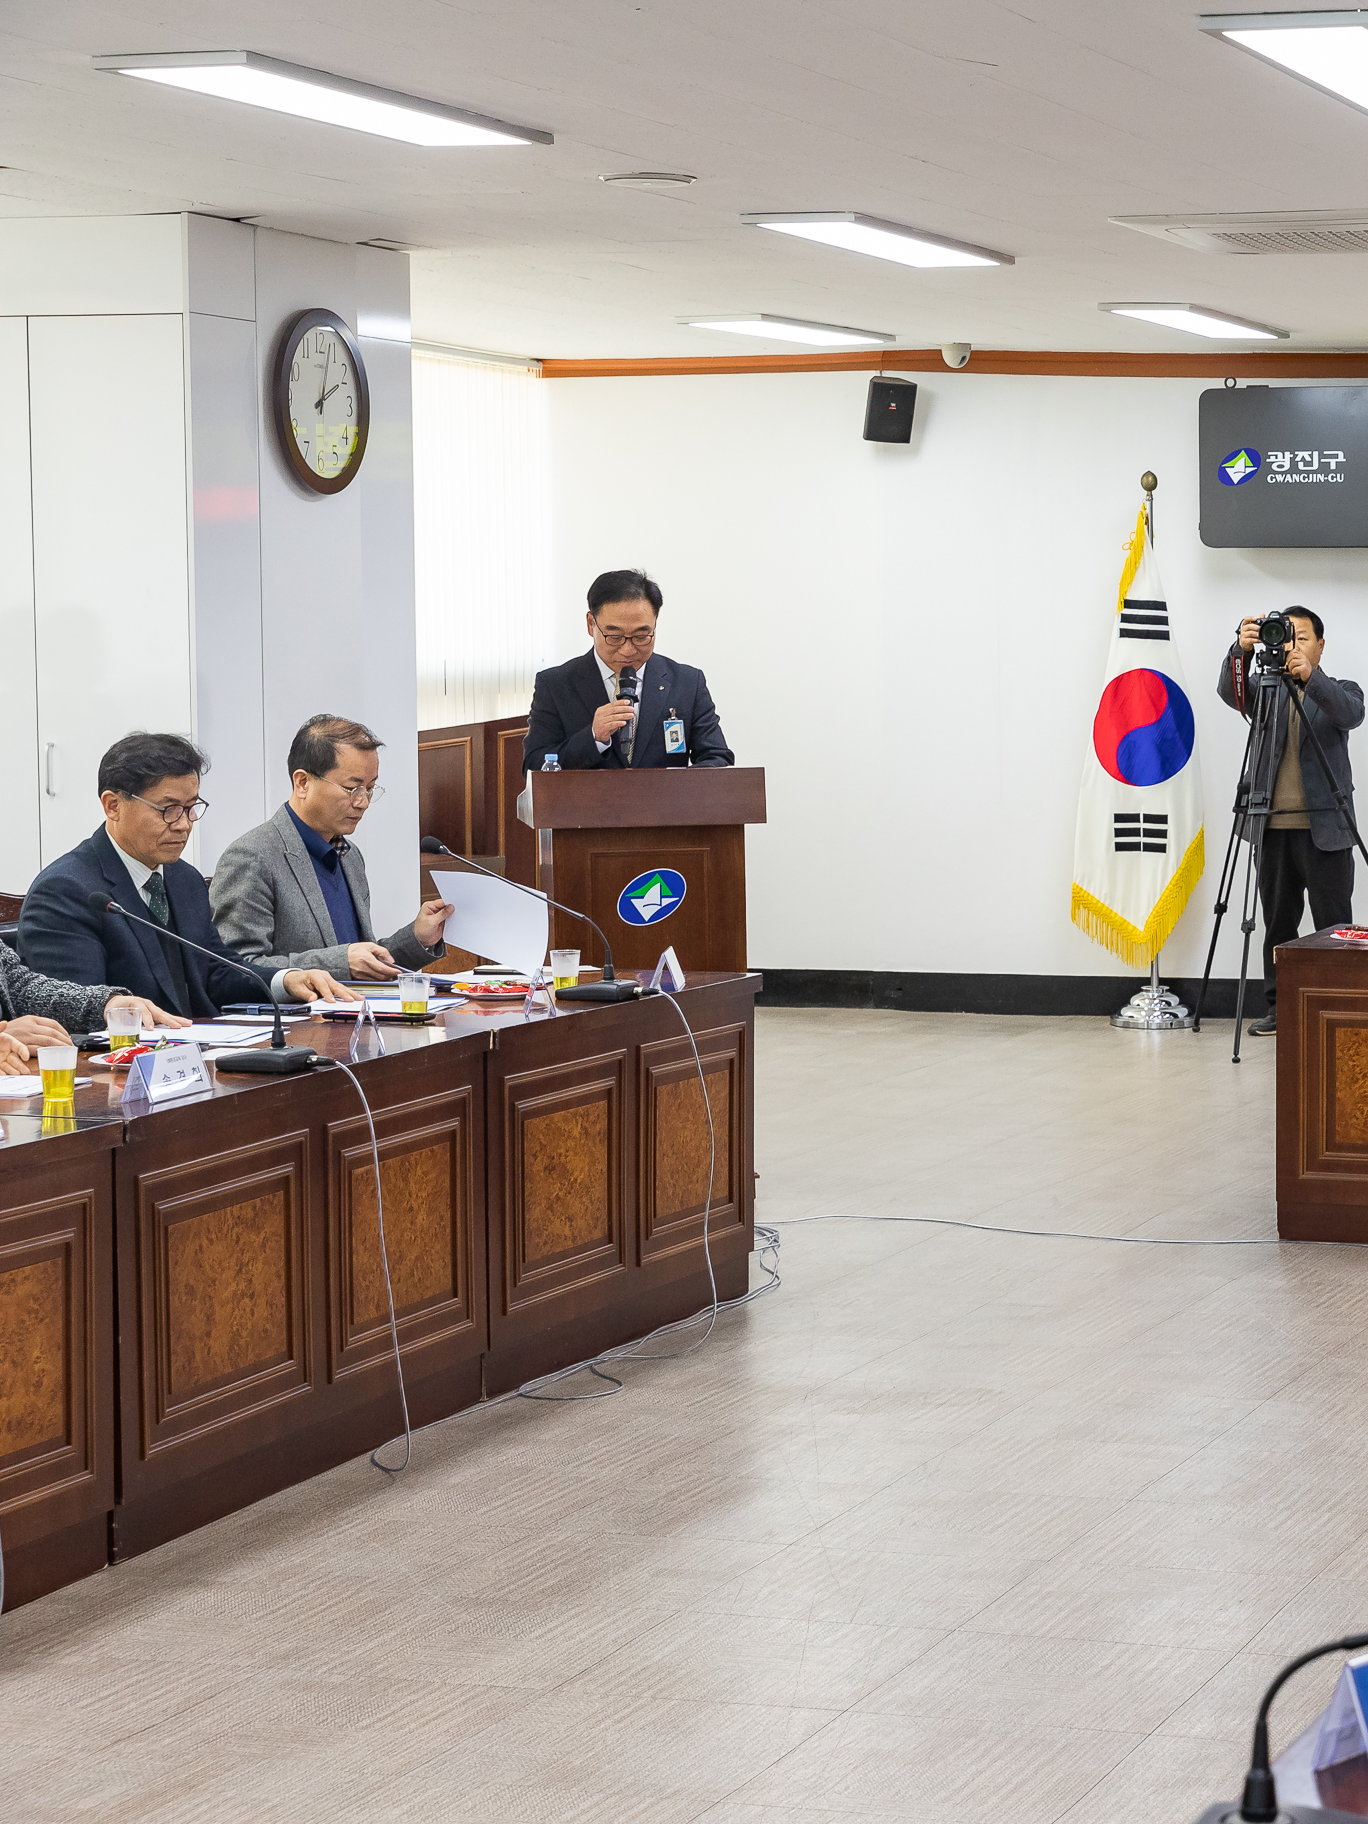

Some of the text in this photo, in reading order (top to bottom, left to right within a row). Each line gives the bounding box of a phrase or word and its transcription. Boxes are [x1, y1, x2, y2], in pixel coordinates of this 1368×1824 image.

[302, 337, 310, 359] 11
[315, 332, 325, 354] 12
[332, 342, 337, 363] 1
[341, 363, 348, 385] 2
[346, 395, 353, 417] 3
[341, 424, 349, 446] 4
[303, 440, 310, 461] 7
[317, 450, 325, 473] 6
[332, 444, 339, 466] 5
[1266, 450, 1346, 472] 광진구
[1266, 473, 1345, 484] GWANGJIN-GU
